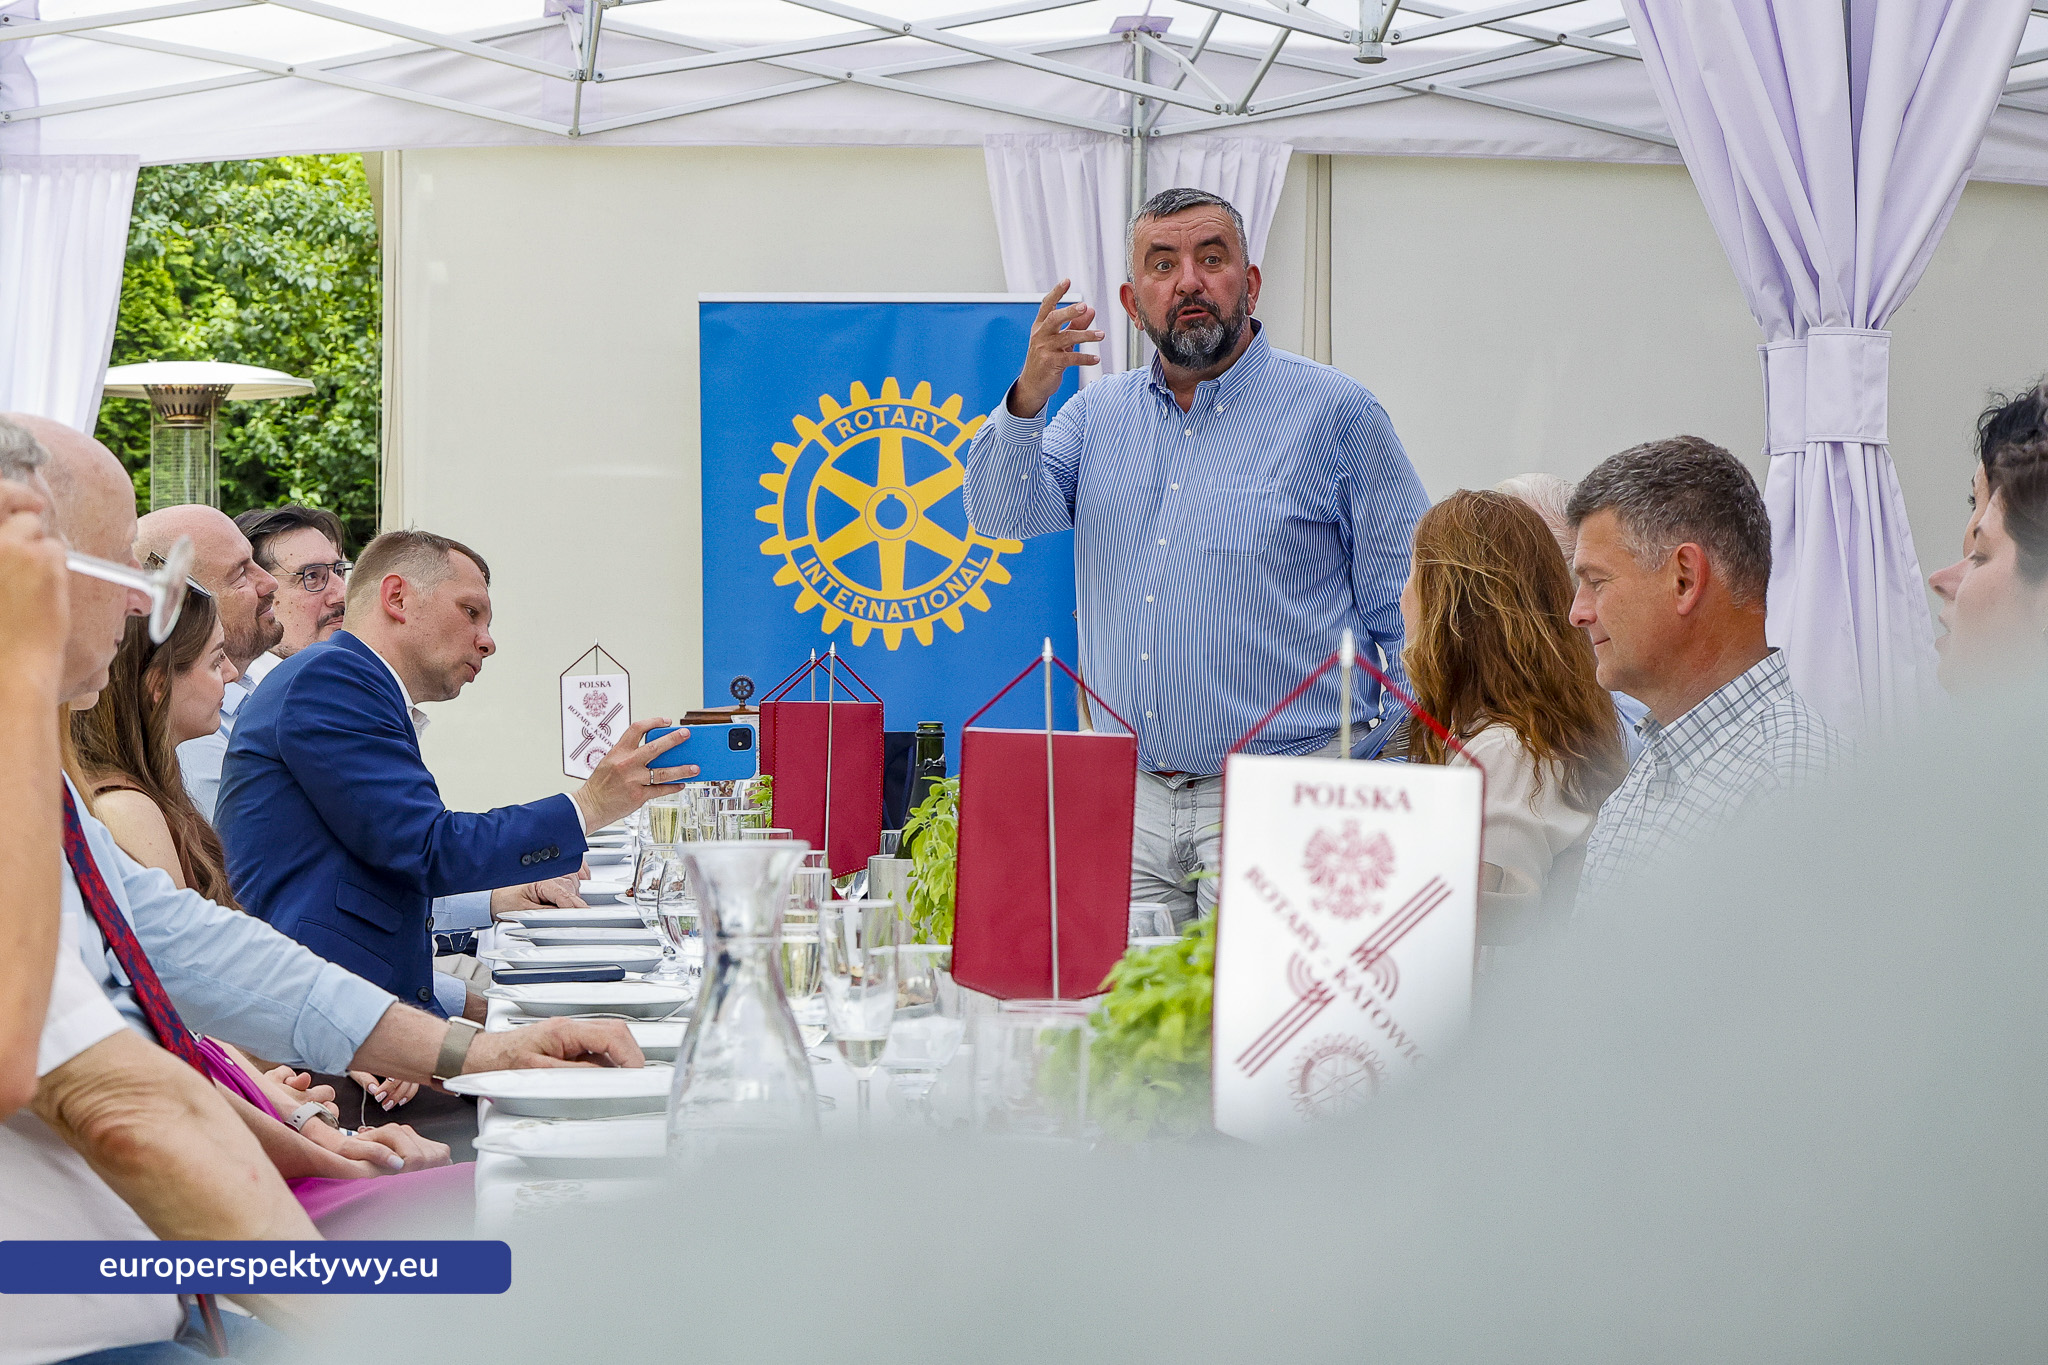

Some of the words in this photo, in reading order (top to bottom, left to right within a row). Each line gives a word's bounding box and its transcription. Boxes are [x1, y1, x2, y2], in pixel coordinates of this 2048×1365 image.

[835, 406, 947, 439] ROTARY
[800, 556, 988, 621] INTERNATIONAL
[579, 680, 612, 689] POLSKA
[568, 705, 591, 727] ROTARY
[593, 728, 615, 749] KATOW
[1293, 782, 1412, 811] POLSKA
[1244, 866, 1323, 953] ROTARY
[1334, 966, 1428, 1069] KATOWIC
